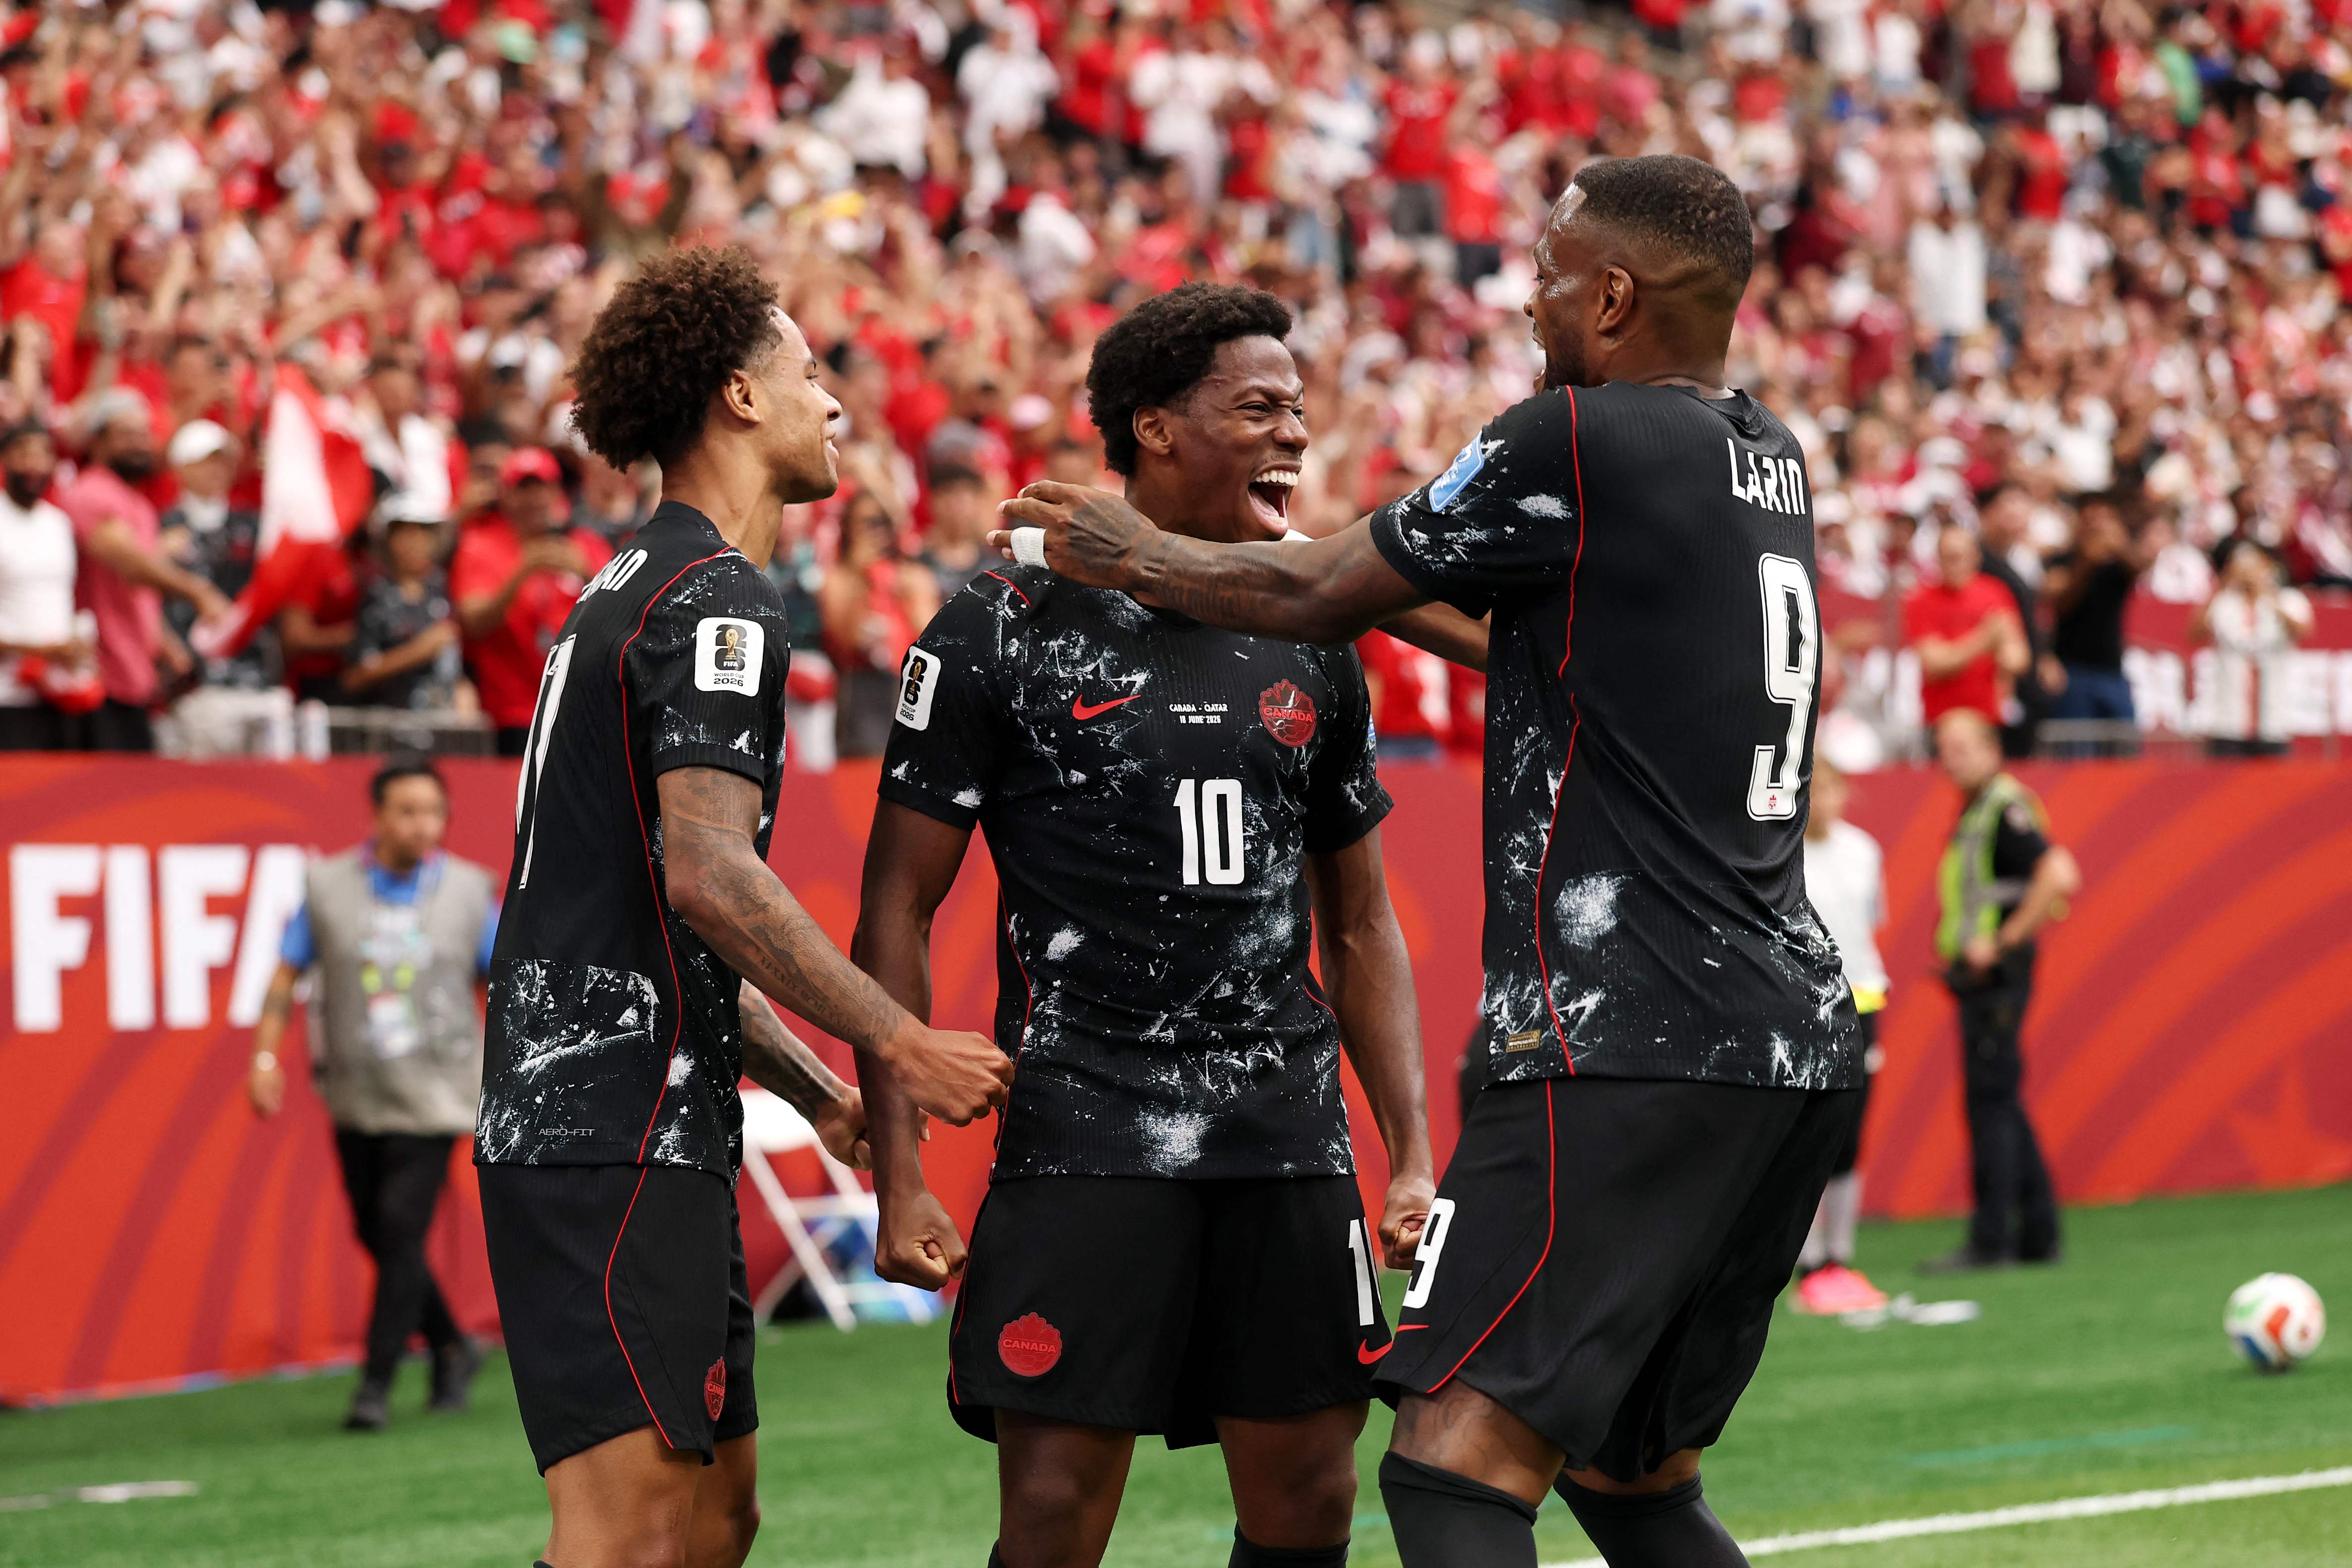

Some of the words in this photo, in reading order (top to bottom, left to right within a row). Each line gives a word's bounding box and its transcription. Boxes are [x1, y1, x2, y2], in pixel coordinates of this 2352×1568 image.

[1726, 437, 1806, 515] LARIN
[714, 678, 744, 687] 2026
[1747, 553, 1818, 821] 9
[900, 708, 915, 721] 2026
[1169, 704, 1197, 712] CANADA
[1204, 703, 1228, 712] QATAR
[1263, 707, 1314, 723] CANADA
[1179, 715, 1187, 724] 18
[1188, 715, 1204, 724] JUNE
[1205, 715, 1221, 724] 2026
[1173, 778, 1245, 885] 10
[538, 1128, 595, 1136] AERO-FIT
[1402, 1197, 1456, 1309] 9
[1348, 1217, 1382, 1326] 1
[1002, 1338, 1057, 1353] CANADA
